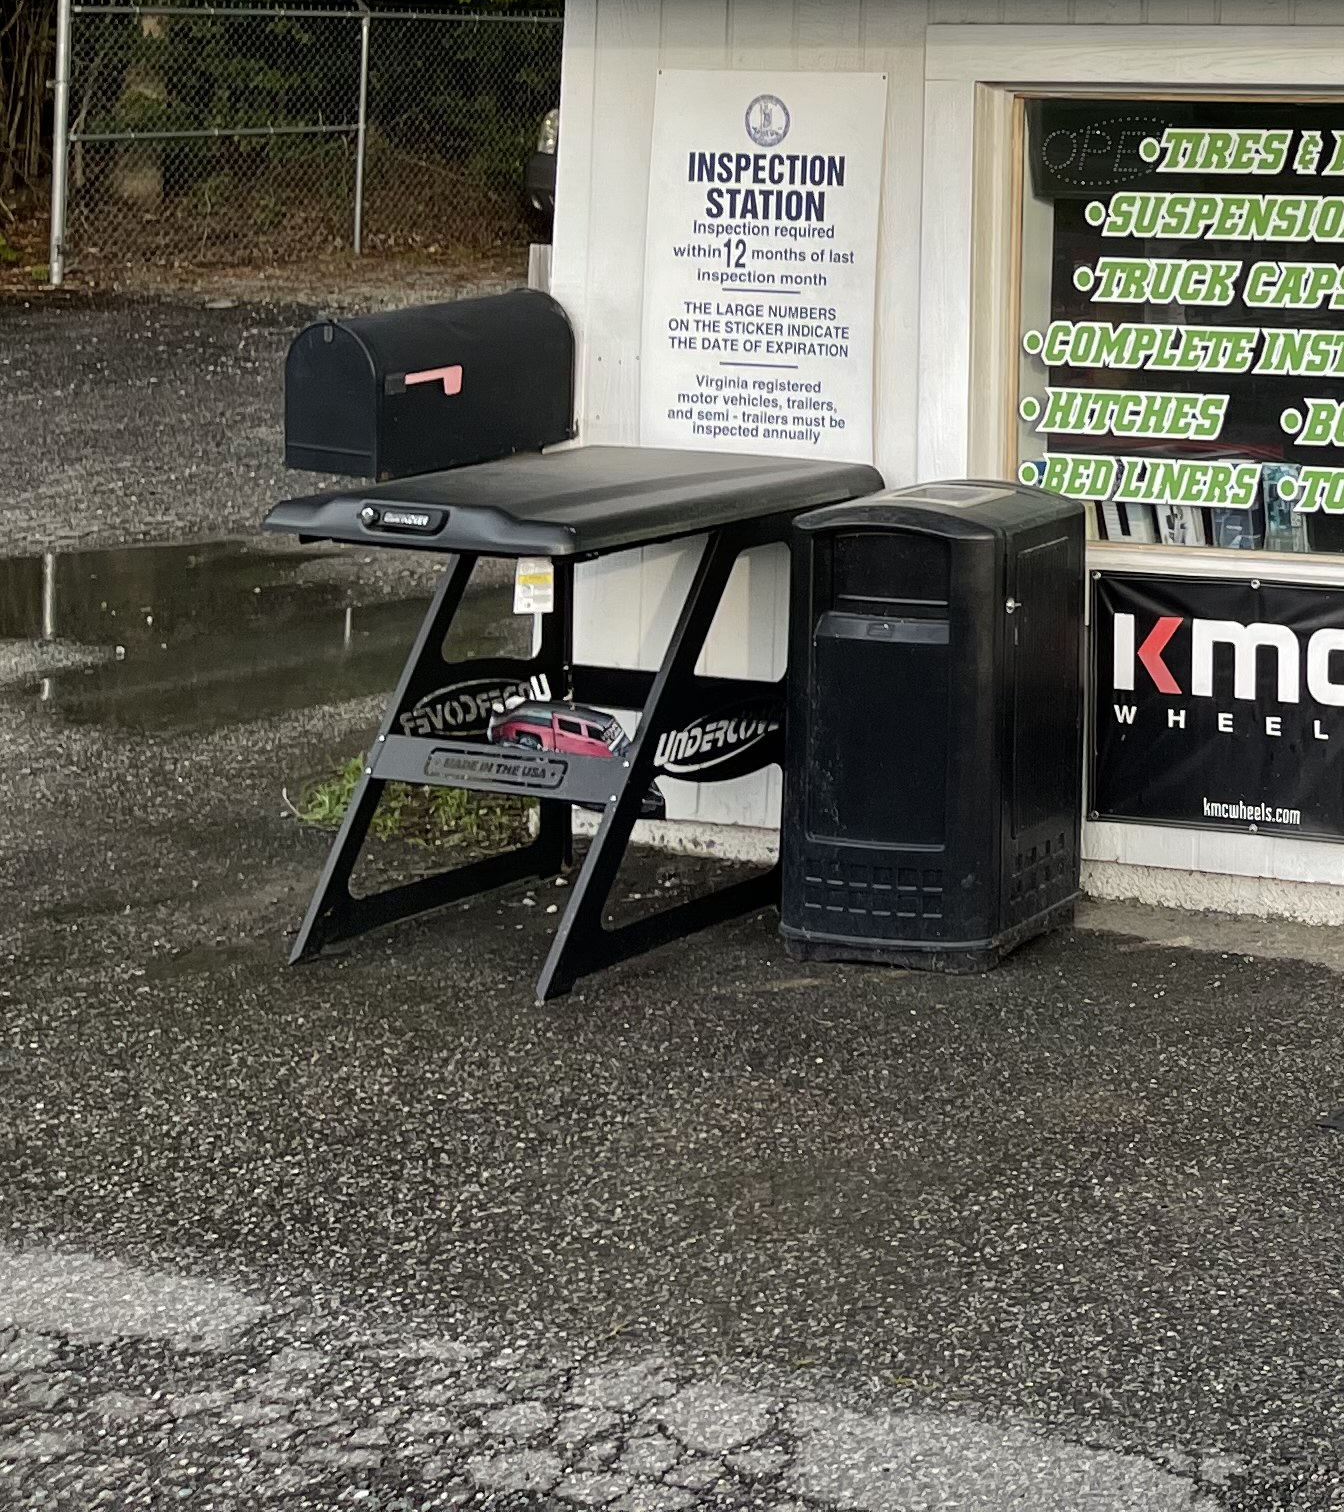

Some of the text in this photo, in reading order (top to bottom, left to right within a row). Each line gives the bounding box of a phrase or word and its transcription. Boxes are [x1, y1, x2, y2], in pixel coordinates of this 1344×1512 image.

[688, 152, 845, 186] INSPECTION
[1157, 129, 1293, 175] TIRES
[1295, 130, 1322, 174] &
[706, 188, 825, 222] STATION
[694, 221, 835, 240] Inspection required
[1091, 257, 1243, 305] TRUCK
[1042, 321, 1264, 372] COMPLETE
[1036, 387, 1230, 439] HITCHES
[1040, 454, 1264, 507] BED LINERS
[1203, 797, 1300, 825] kmcwheels.com
